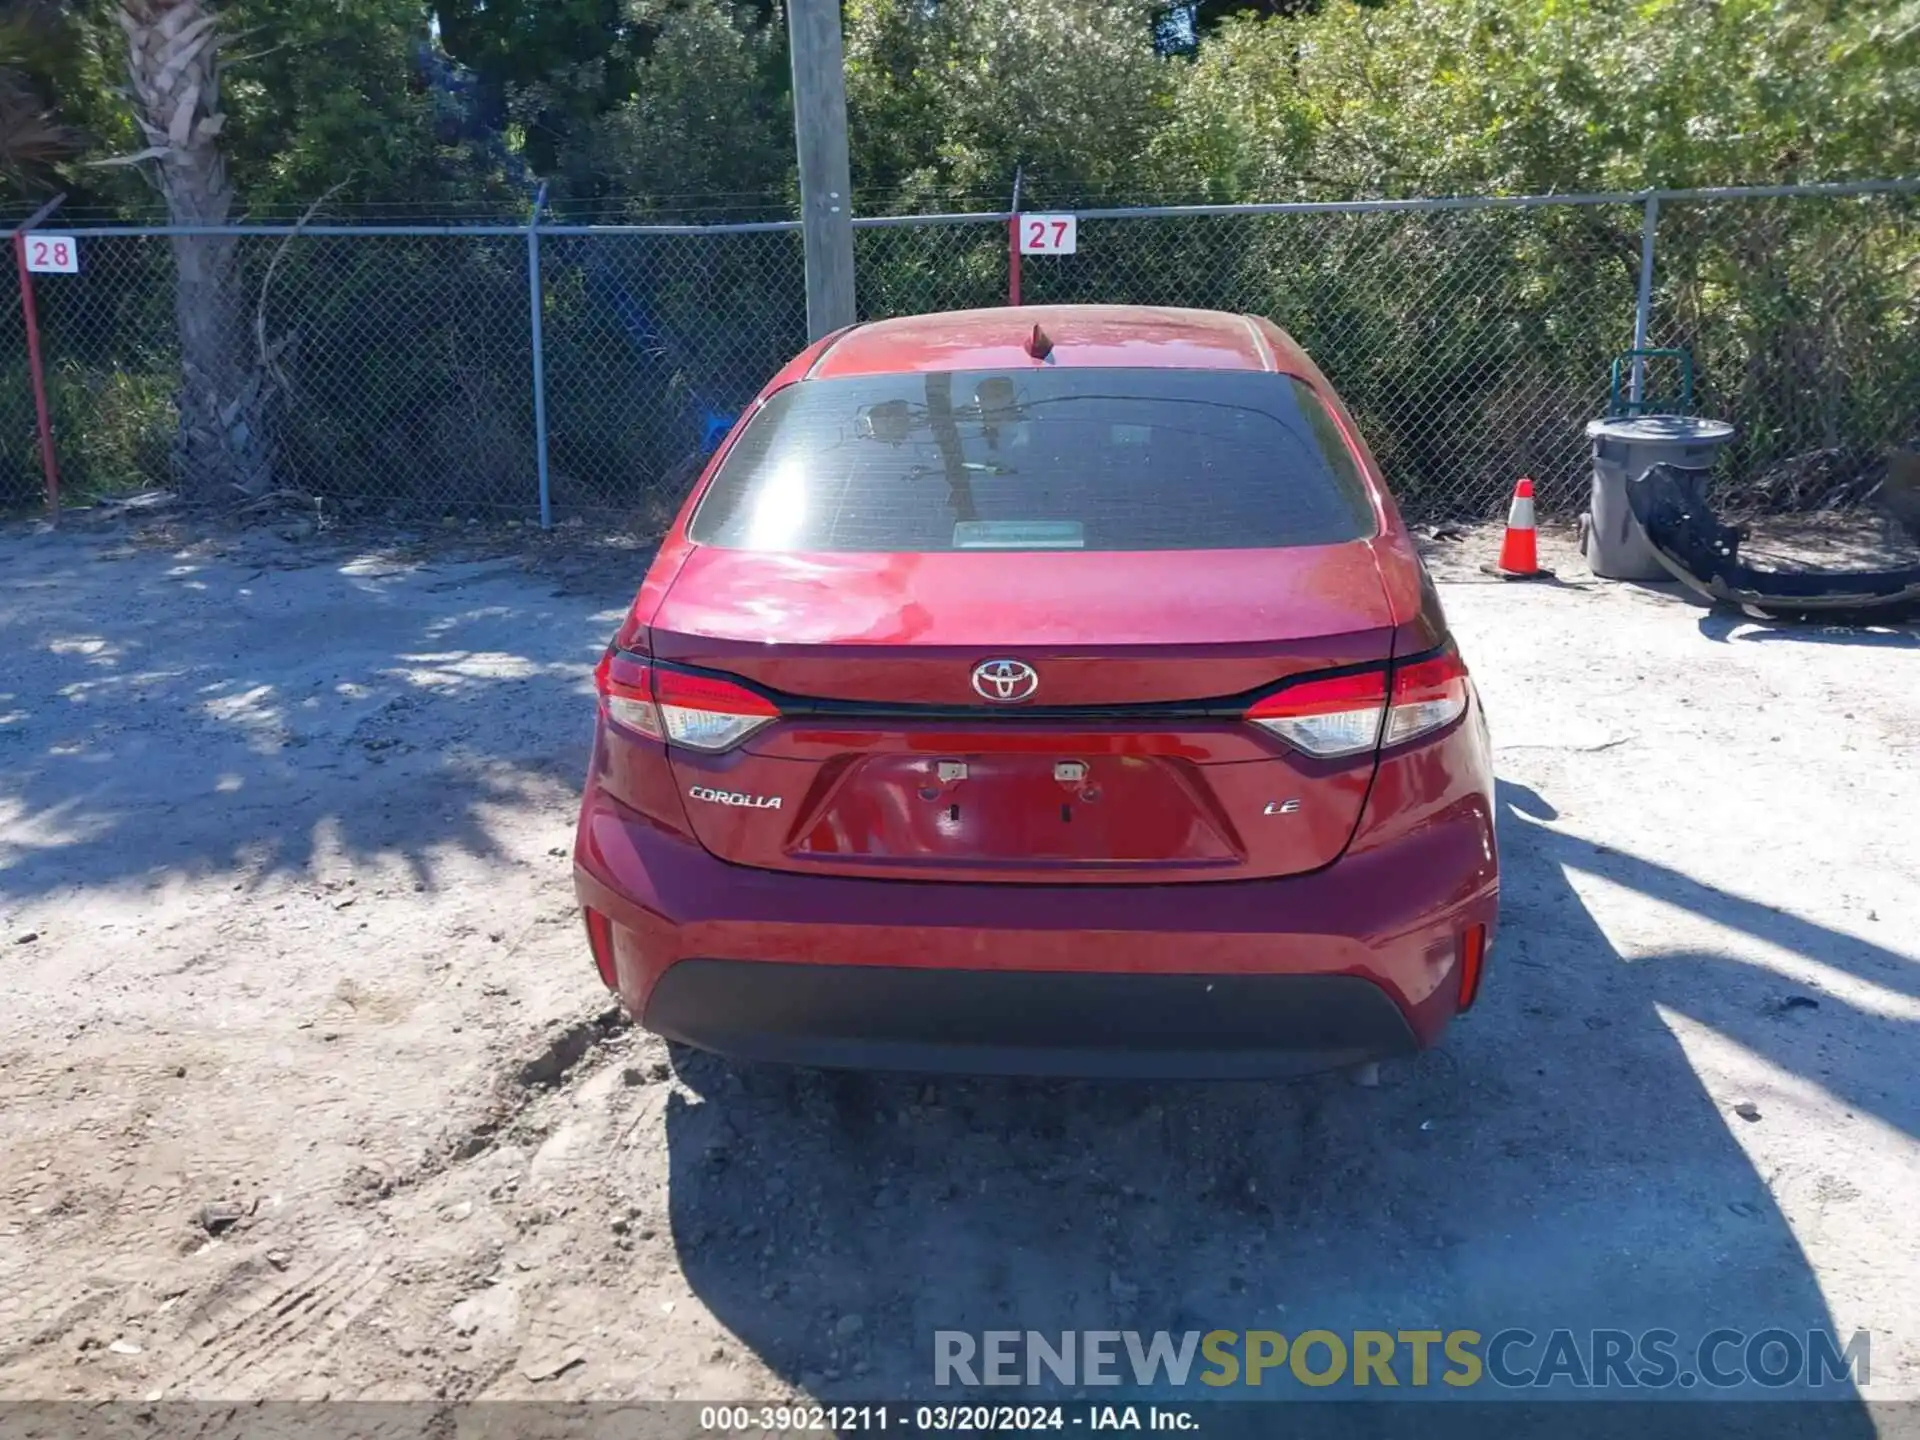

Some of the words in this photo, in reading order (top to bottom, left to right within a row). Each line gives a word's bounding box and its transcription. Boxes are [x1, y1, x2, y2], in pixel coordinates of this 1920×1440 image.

[1029, 222, 1067, 248] 27
[33, 242, 68, 266] 28
[689, 785, 782, 809] COROLLA
[1263, 799, 1301, 816] LE
